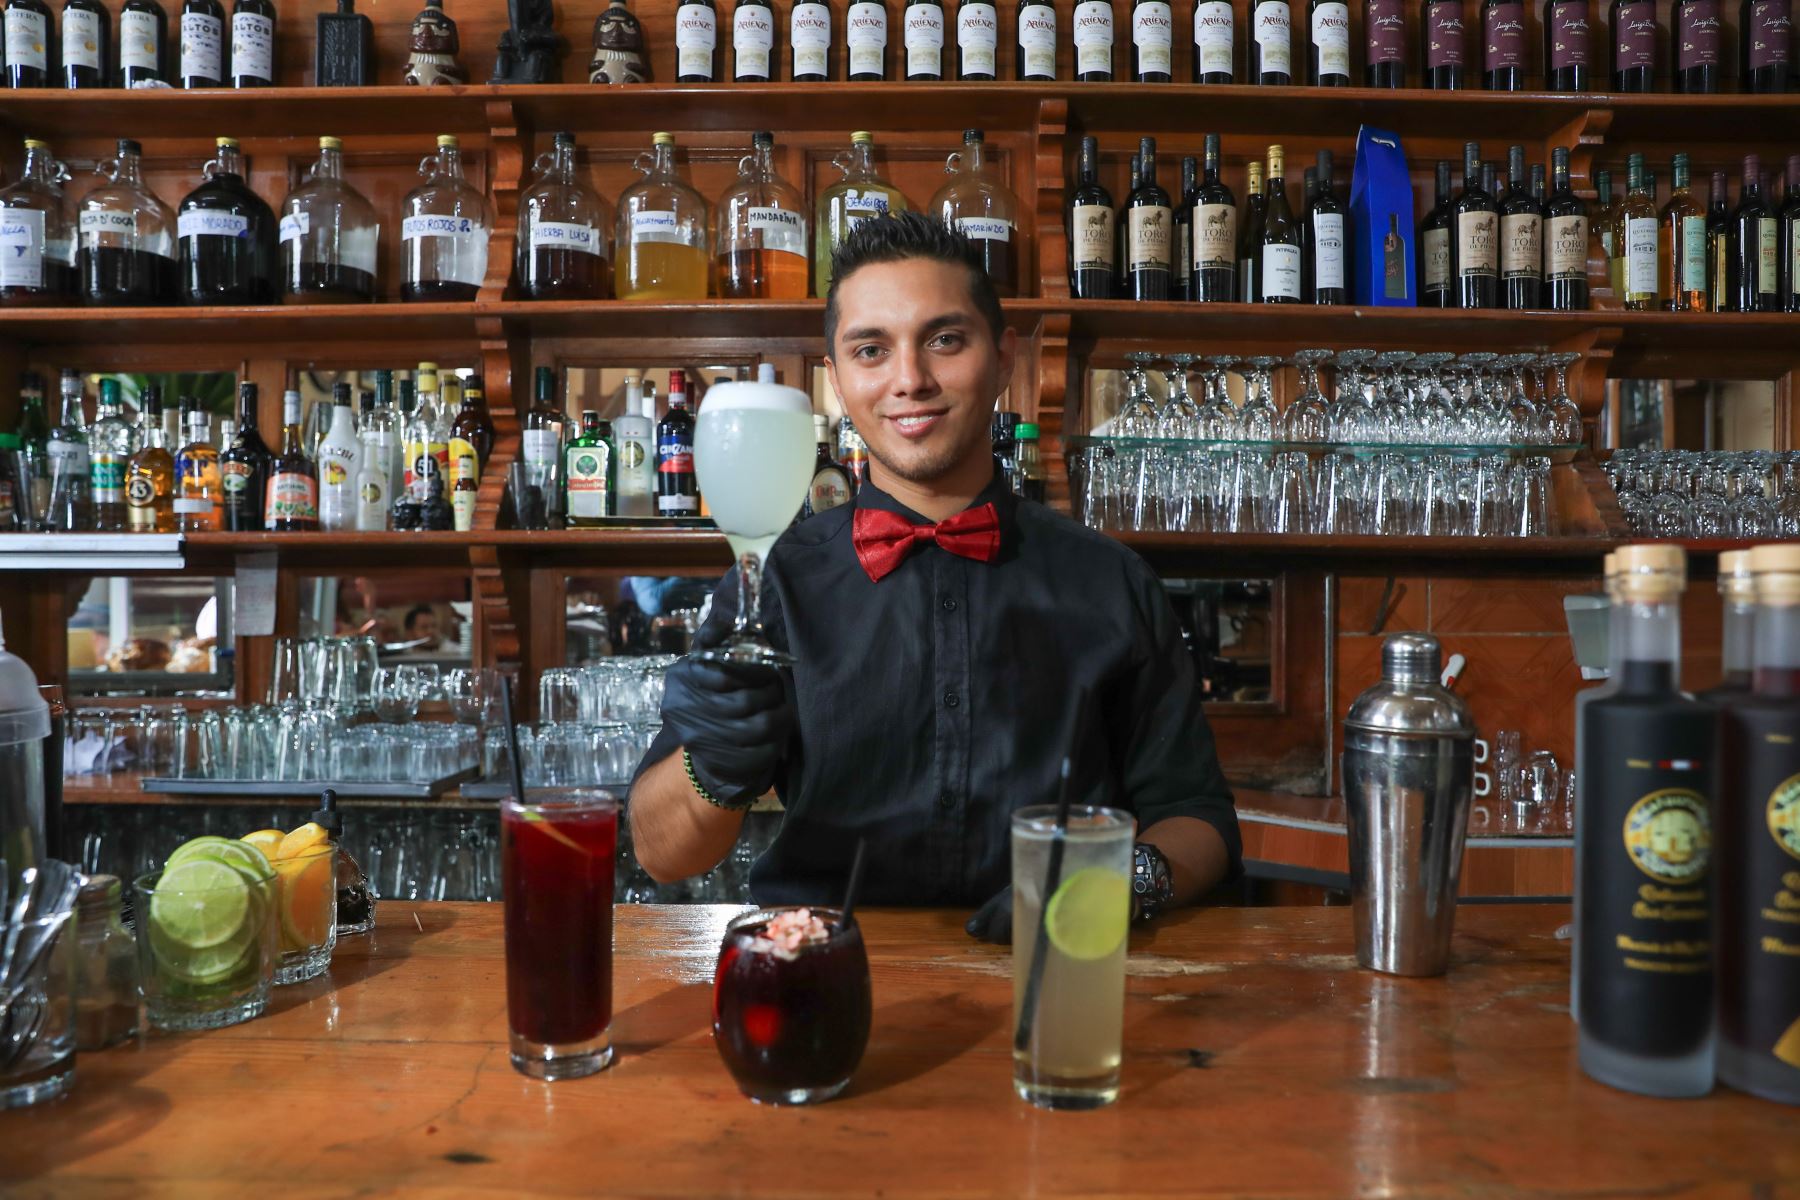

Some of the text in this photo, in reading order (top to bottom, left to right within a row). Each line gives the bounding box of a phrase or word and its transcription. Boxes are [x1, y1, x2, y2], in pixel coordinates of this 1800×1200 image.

[750, 212, 798, 226] MANDARINA
[427, 219, 456, 232] ROJOS
[962, 222, 1004, 234] AMARINDO
[535, 228, 564, 239] HIERBA
[1138, 229, 1167, 239] TORO
[1203, 229, 1233, 237] TORO
[1555, 240, 1585, 248] TORO
[1432, 252, 1449, 260] TO
[659, 443, 696, 455] CINZAN
[417, 458, 433, 474] 51
[129, 481, 147, 498] 43
